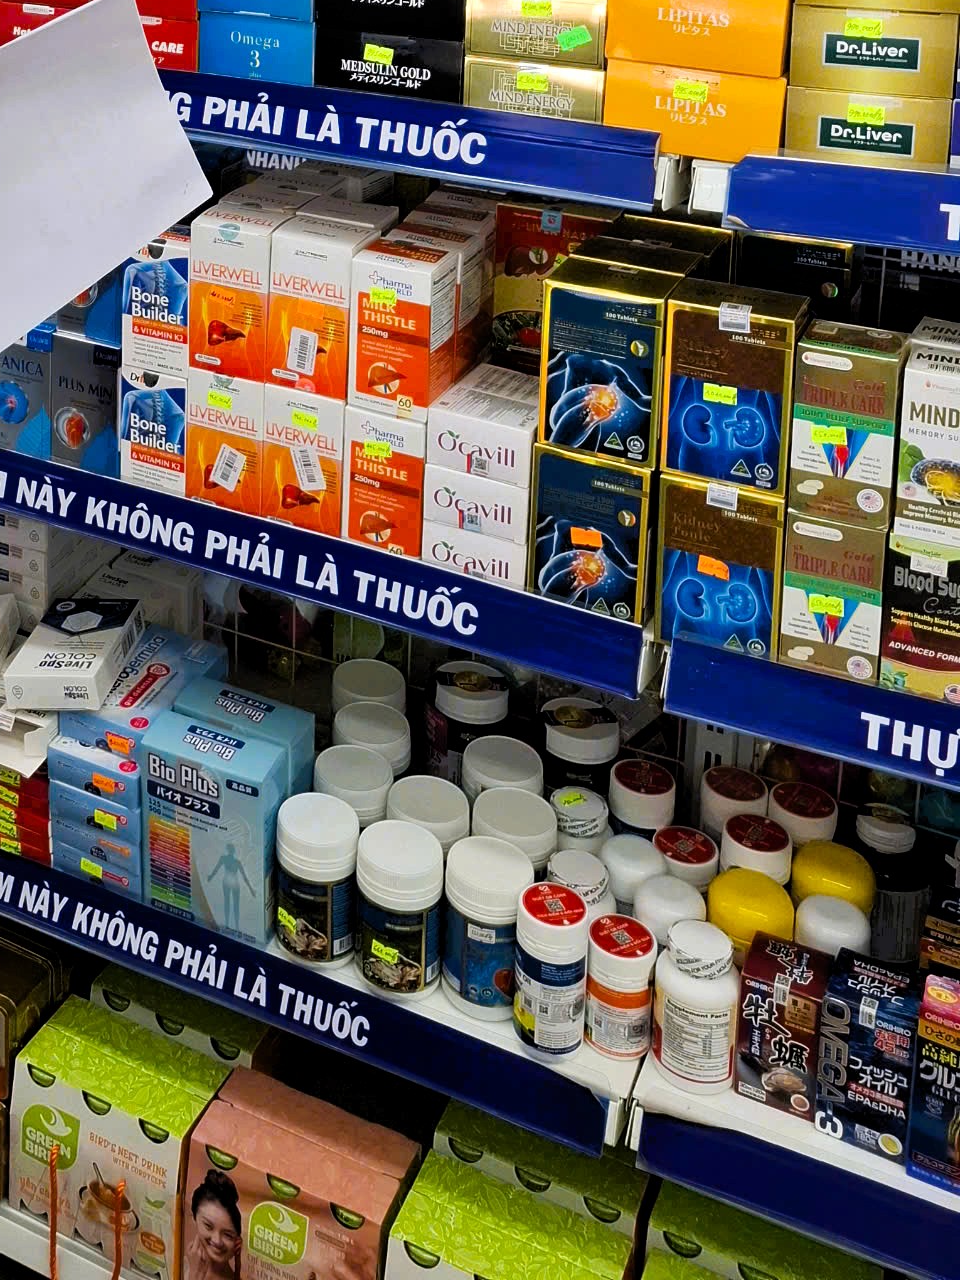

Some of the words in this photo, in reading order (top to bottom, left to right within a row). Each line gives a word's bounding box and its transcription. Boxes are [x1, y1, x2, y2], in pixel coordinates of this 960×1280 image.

[657, 7, 730, 27] LIPITAS
[151, 42, 184, 54] CARE
[230, 30, 280, 49] Omega
[836, 40, 908, 57] Dr.Liver
[340, 59, 399, 76] MEDSULIN
[400, 67, 431, 81] GOLD
[202, 93, 283, 138] PHẢI
[295, 104, 340, 144] LÀ
[356, 116, 487, 165] THUỐC
[192, 260, 263, 286] LIVERWELL
[131, 287, 169, 307] Bone
[272, 273, 346, 300] LIVERWELL
[131, 302, 184, 325] Builder
[363, 310, 416, 330] THISTLE
[617, 313, 638, 322] Tablets
[361, 326, 388, 337] 250mg
[743, 336, 766, 345] Tablets
[1, 355, 44, 377] ANICA
[58, 375, 85, 393] PLUS
[87, 382, 113, 400] MIN
[398, 397, 412, 408] 60
[130, 412, 167, 432] Bone
[130, 429, 181, 453] Builder
[908, 427, 945, 440] MEMORY
[354, 473, 380, 487] 250mg
[15, 476, 76, 518] NÀY
[85, 499, 193, 555] KHÔNG
[205, 533, 283, 580] PHẢI
[295, 553, 339, 596] LÀ
[352, 570, 480, 637] THUỐC
[893, 566, 934, 594] Blood
[147, 752, 176, 783] Bio
[180, 761, 220, 799] Plus
[18, 879, 68, 922] NÀY
[72, 900, 160, 961] KHÔNG
[163, 937, 228, 991] PHẢI
[233, 966, 269, 1008] LÀ
[278, 982, 371, 1048] THUỐC
[849, 1055, 909, 1088] フィッシュ
[847, 1092, 906, 1120] EPA&DHA
[141, 1155, 169, 1178] DRINK
[254, 1224, 299, 1254] GREEN
